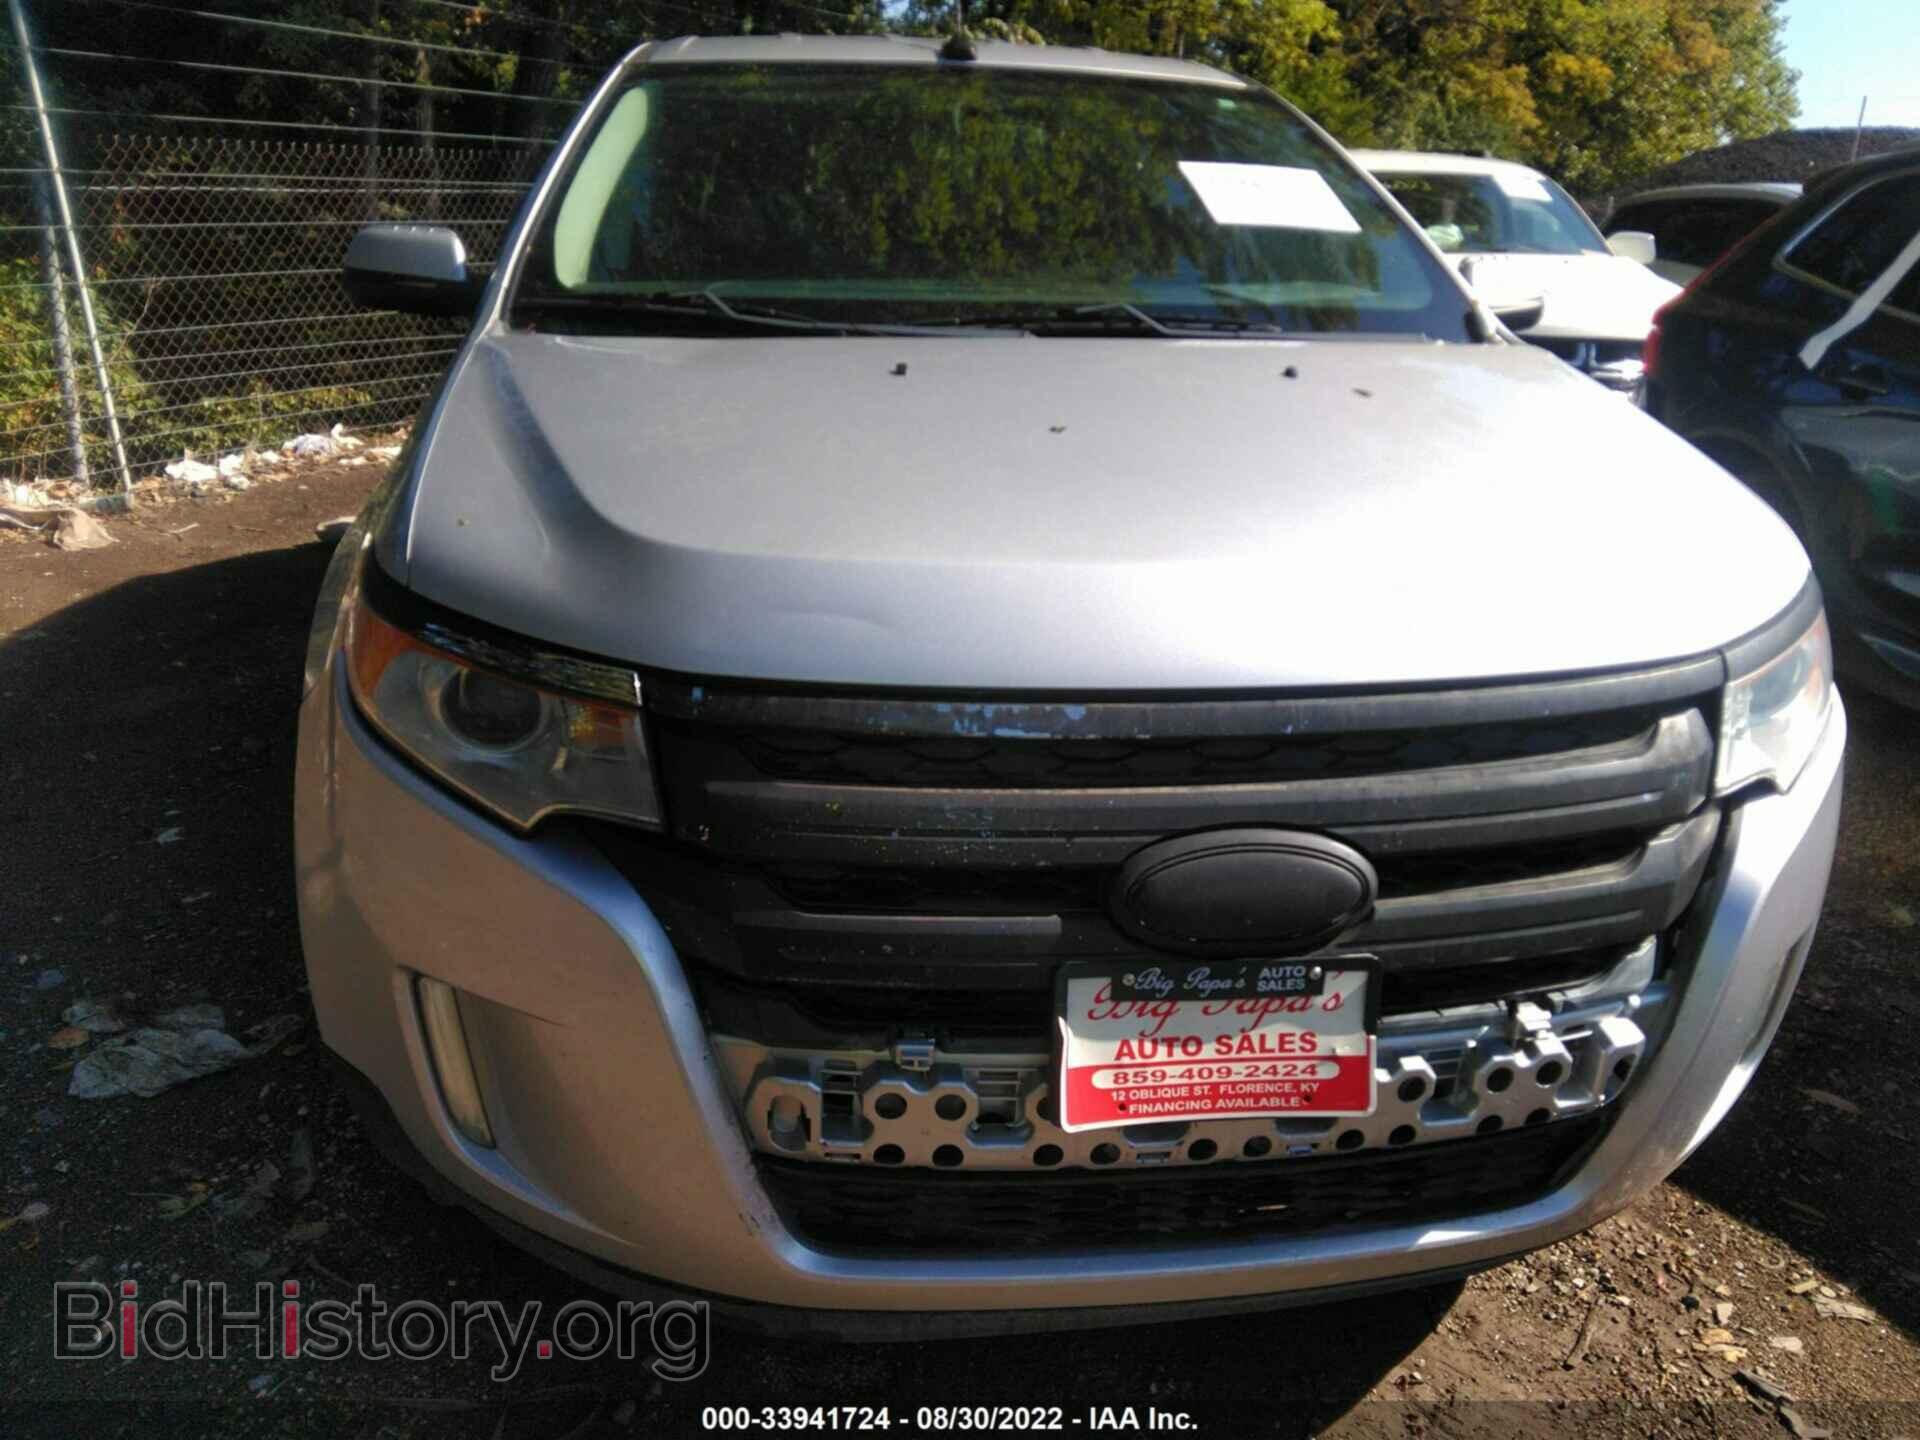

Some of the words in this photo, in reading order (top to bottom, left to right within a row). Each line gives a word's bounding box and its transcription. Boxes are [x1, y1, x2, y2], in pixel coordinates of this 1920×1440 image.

[1134, 967, 1177, 998] Big
[1183, 967, 1247, 998] Papa's
[1258, 966, 1307, 979] AUTO
[1256, 978, 1306, 992] SALES
[1113, 1036, 1203, 1061] AUTO
[1215, 1032, 1318, 1055] SALES
[1112, 1063, 1319, 1086] 859-409-2424
[1111, 1091, 1126, 1102] 12
[1129, 1088, 1189, 1101] OBLIQUE
[1193, 1086, 1211, 1098] ST.
[1300, 1082, 1319, 1093] KY
[1129, 1100, 1212, 1114] FINANCING
[1215, 1097, 1299, 1110] AVAILABLE
